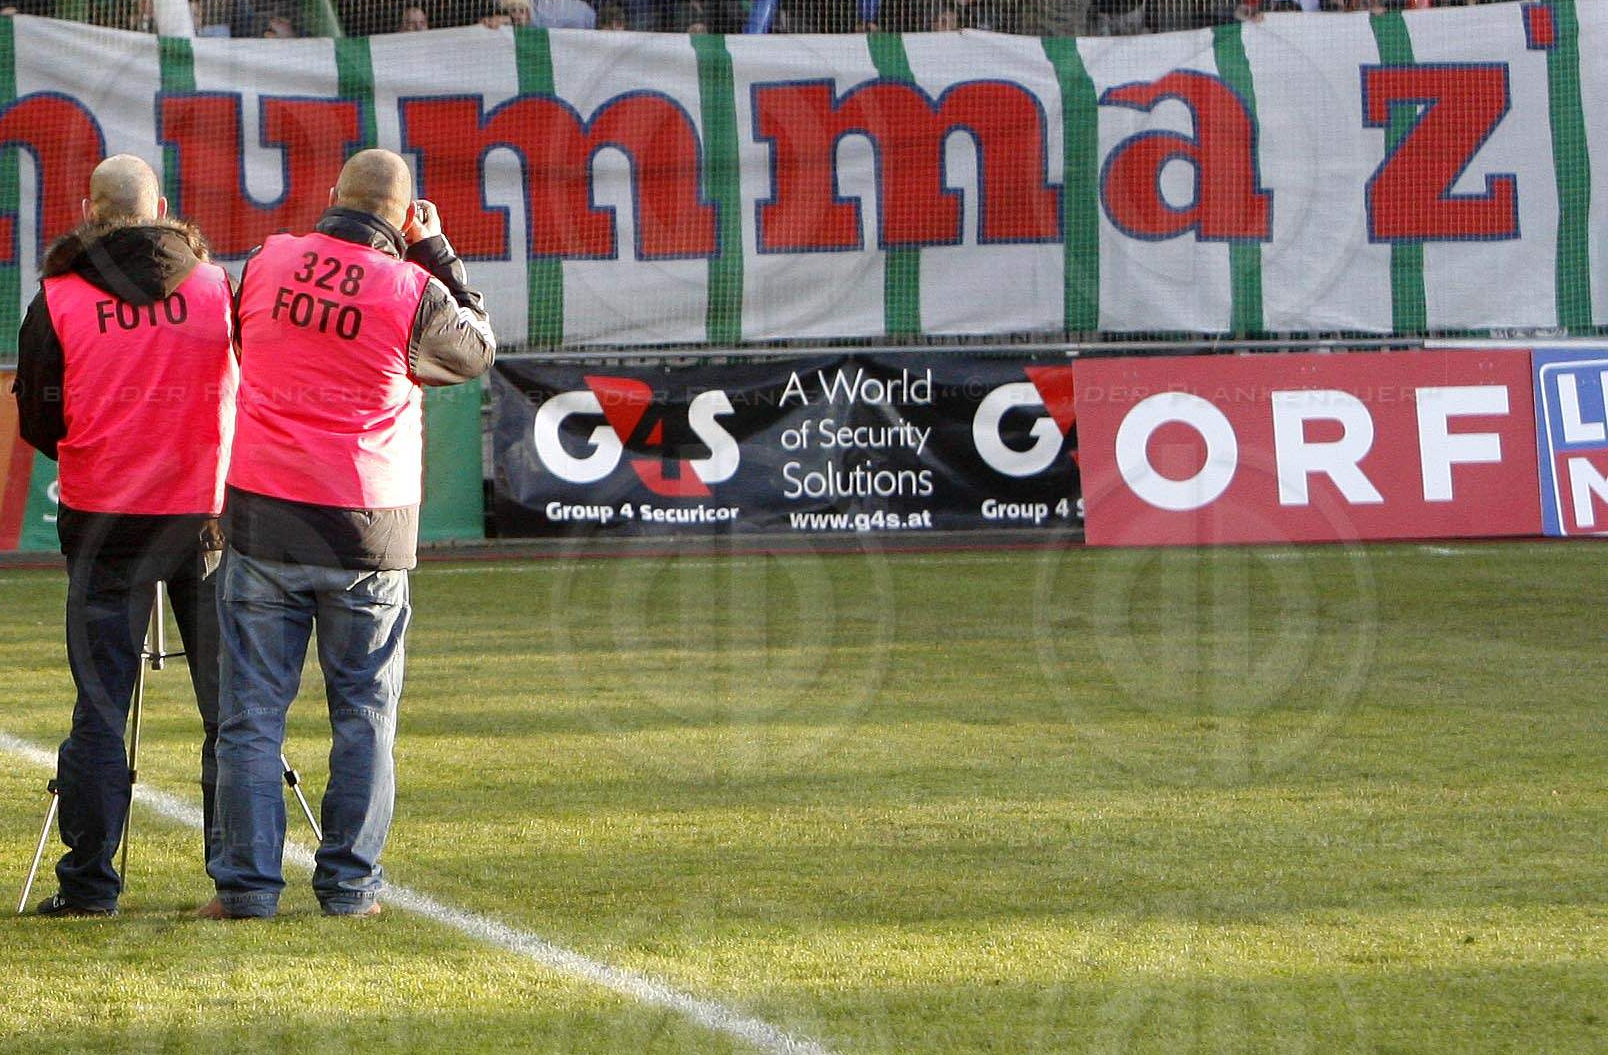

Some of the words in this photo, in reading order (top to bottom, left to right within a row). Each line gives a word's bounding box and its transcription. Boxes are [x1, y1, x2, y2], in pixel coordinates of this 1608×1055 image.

[294, 251, 365, 297] 328
[96, 292, 188, 334] FOTO
[271, 288, 363, 341] FOTO
[779, 370, 809, 407] A
[817, 368, 933, 405] World
[534, 375, 740, 497] G4S
[780, 419, 812, 450] of
[818, 416, 932, 456] Security
[1114, 384, 1510, 511] ORF
[782, 459, 934, 498] Solutions
[545, 501, 614, 523] Group
[620, 502, 634, 519] 4
[640, 504, 740, 523] Securicor
[789, 508, 933, 532] www.g4s.at
[981, 498, 1049, 524] Group
[1054, 498, 1069, 518] 4
